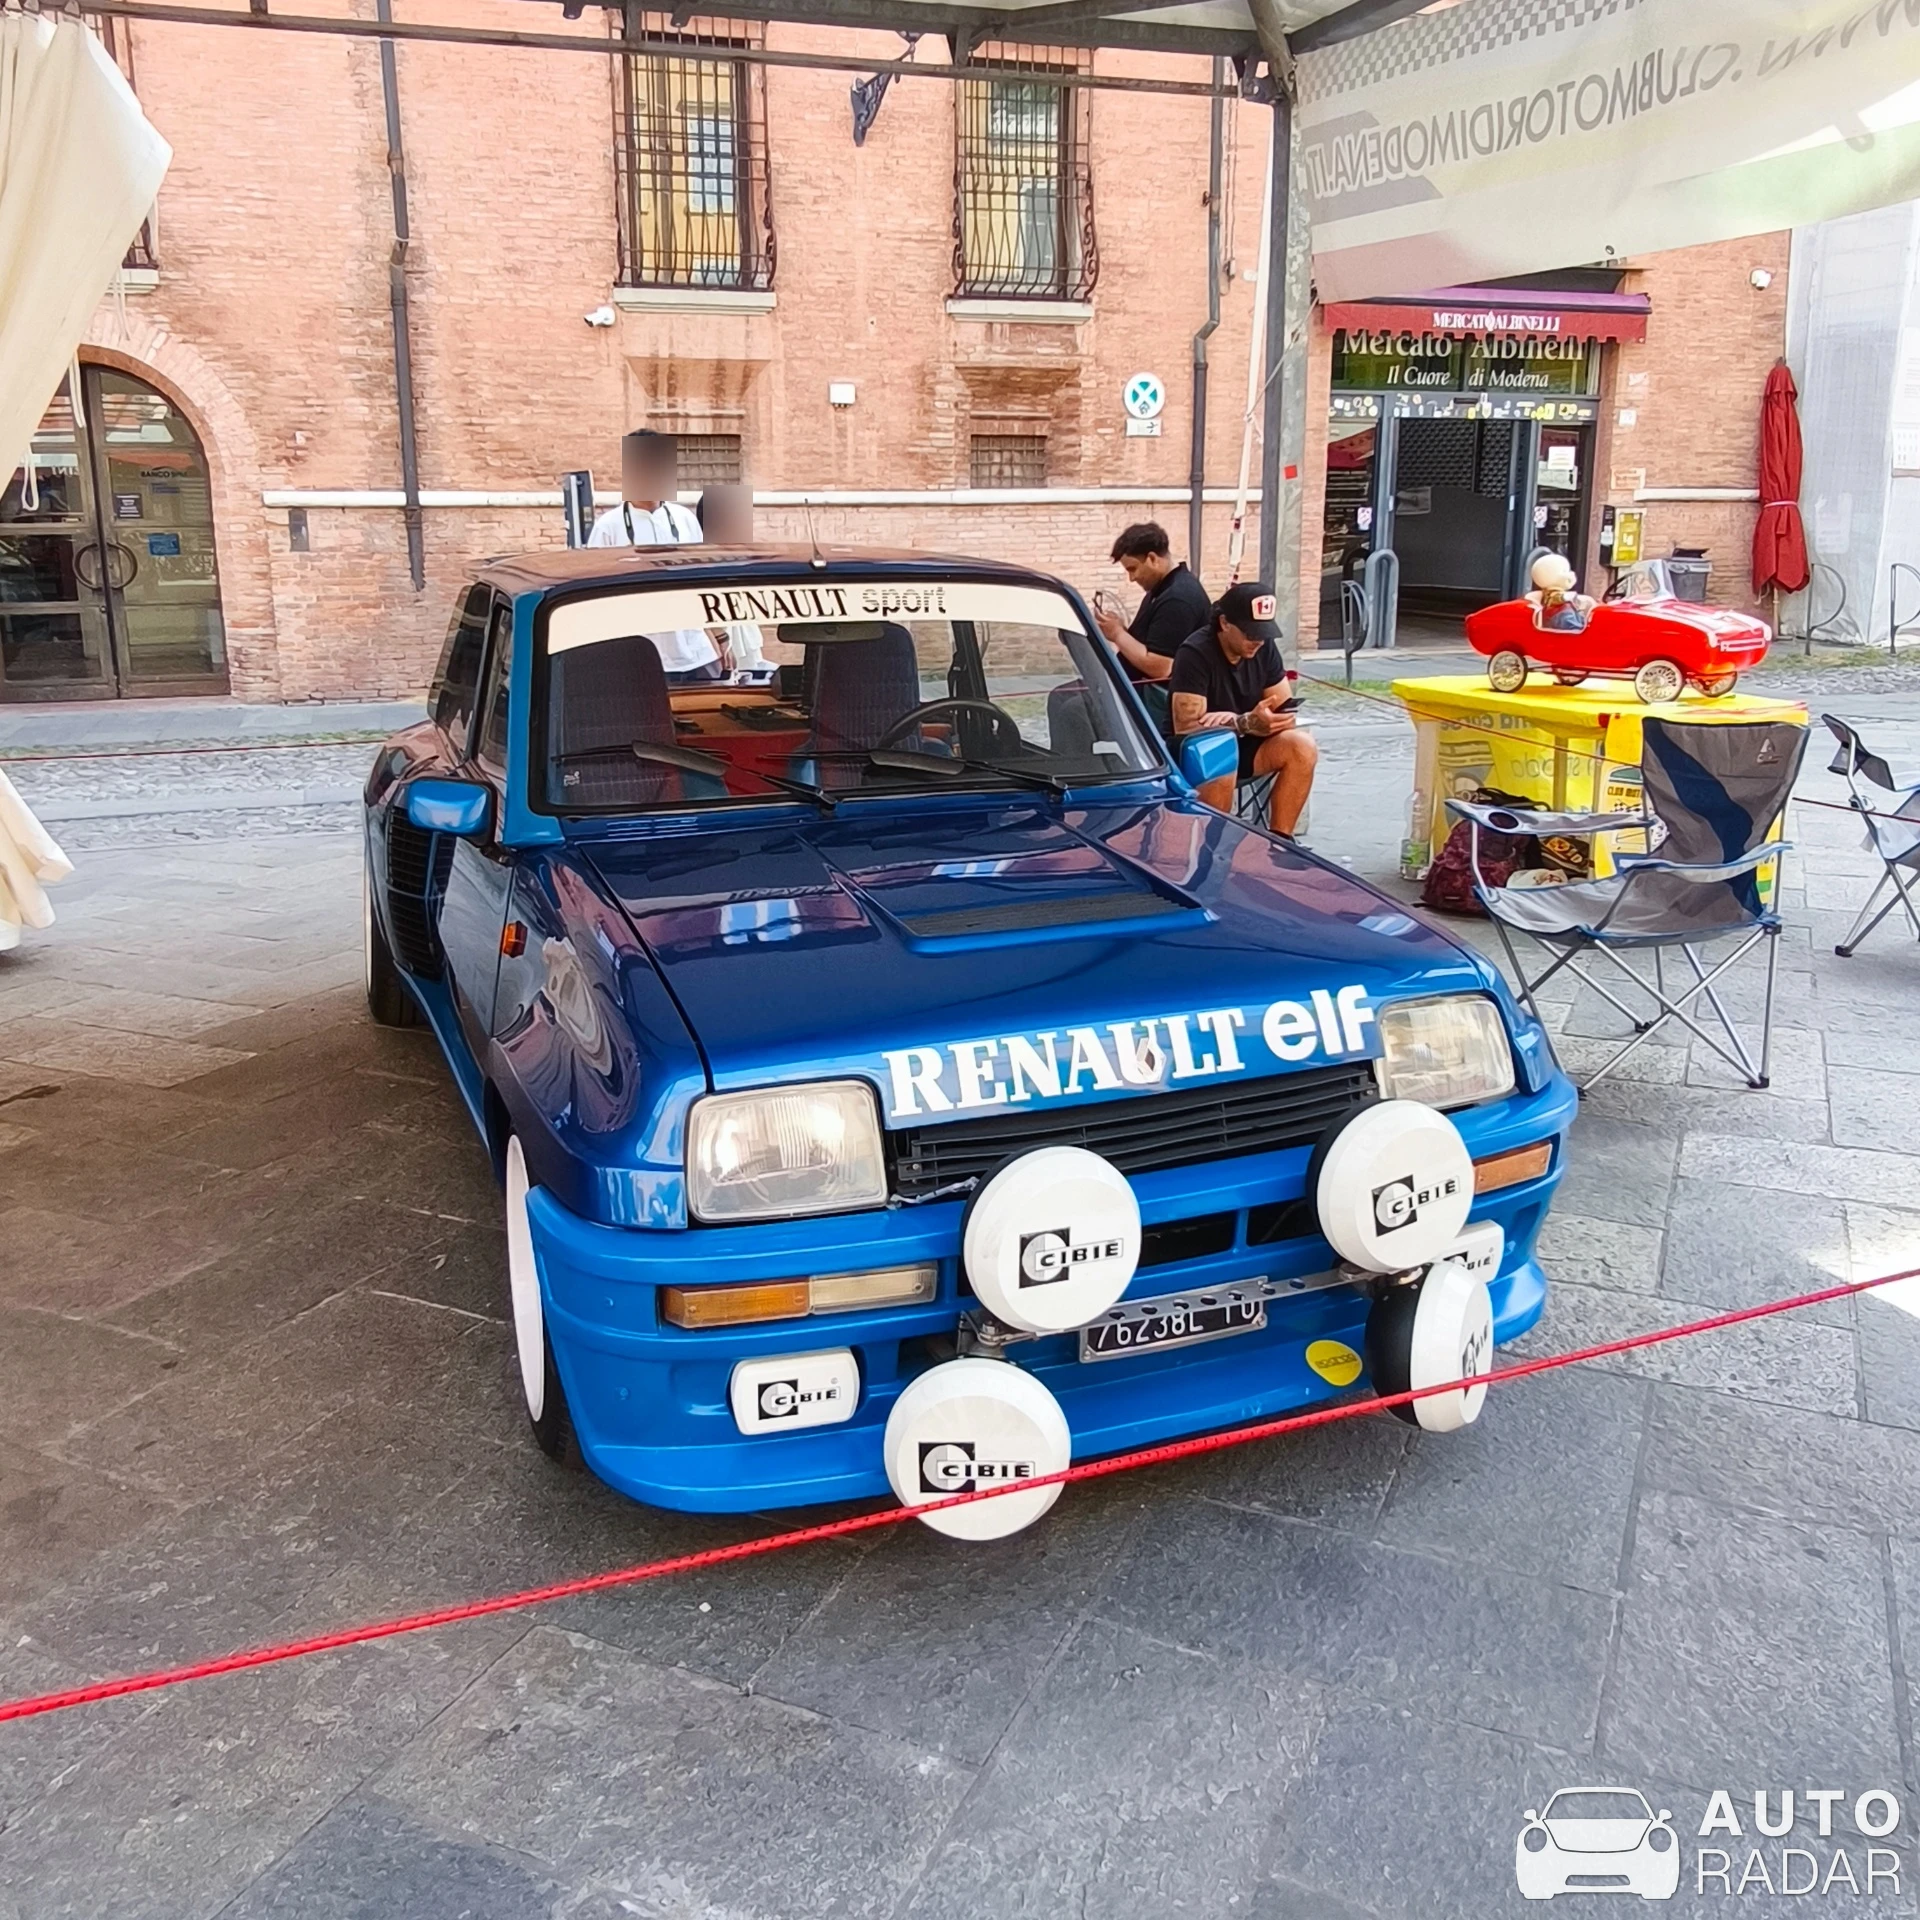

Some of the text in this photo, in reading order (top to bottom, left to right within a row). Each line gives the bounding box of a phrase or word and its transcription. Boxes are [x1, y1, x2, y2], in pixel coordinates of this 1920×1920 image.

[1432, 311, 1560, 331] MERCATO ALBINELLI
[1341, 329, 1453, 357] Mercato
[1386, 365, 1549, 388] Il Cuore di Modena
[699, 587, 947, 623] RENAULT sport
[881, 984, 1376, 1118] RENAULT elf
[1391, 1179, 1456, 1215] CIBIE
[1039, 1242, 1119, 1268] CIBIE
[773, 1389, 838, 1406] CIBIE
[941, 1463, 1032, 1479] CIBIE
